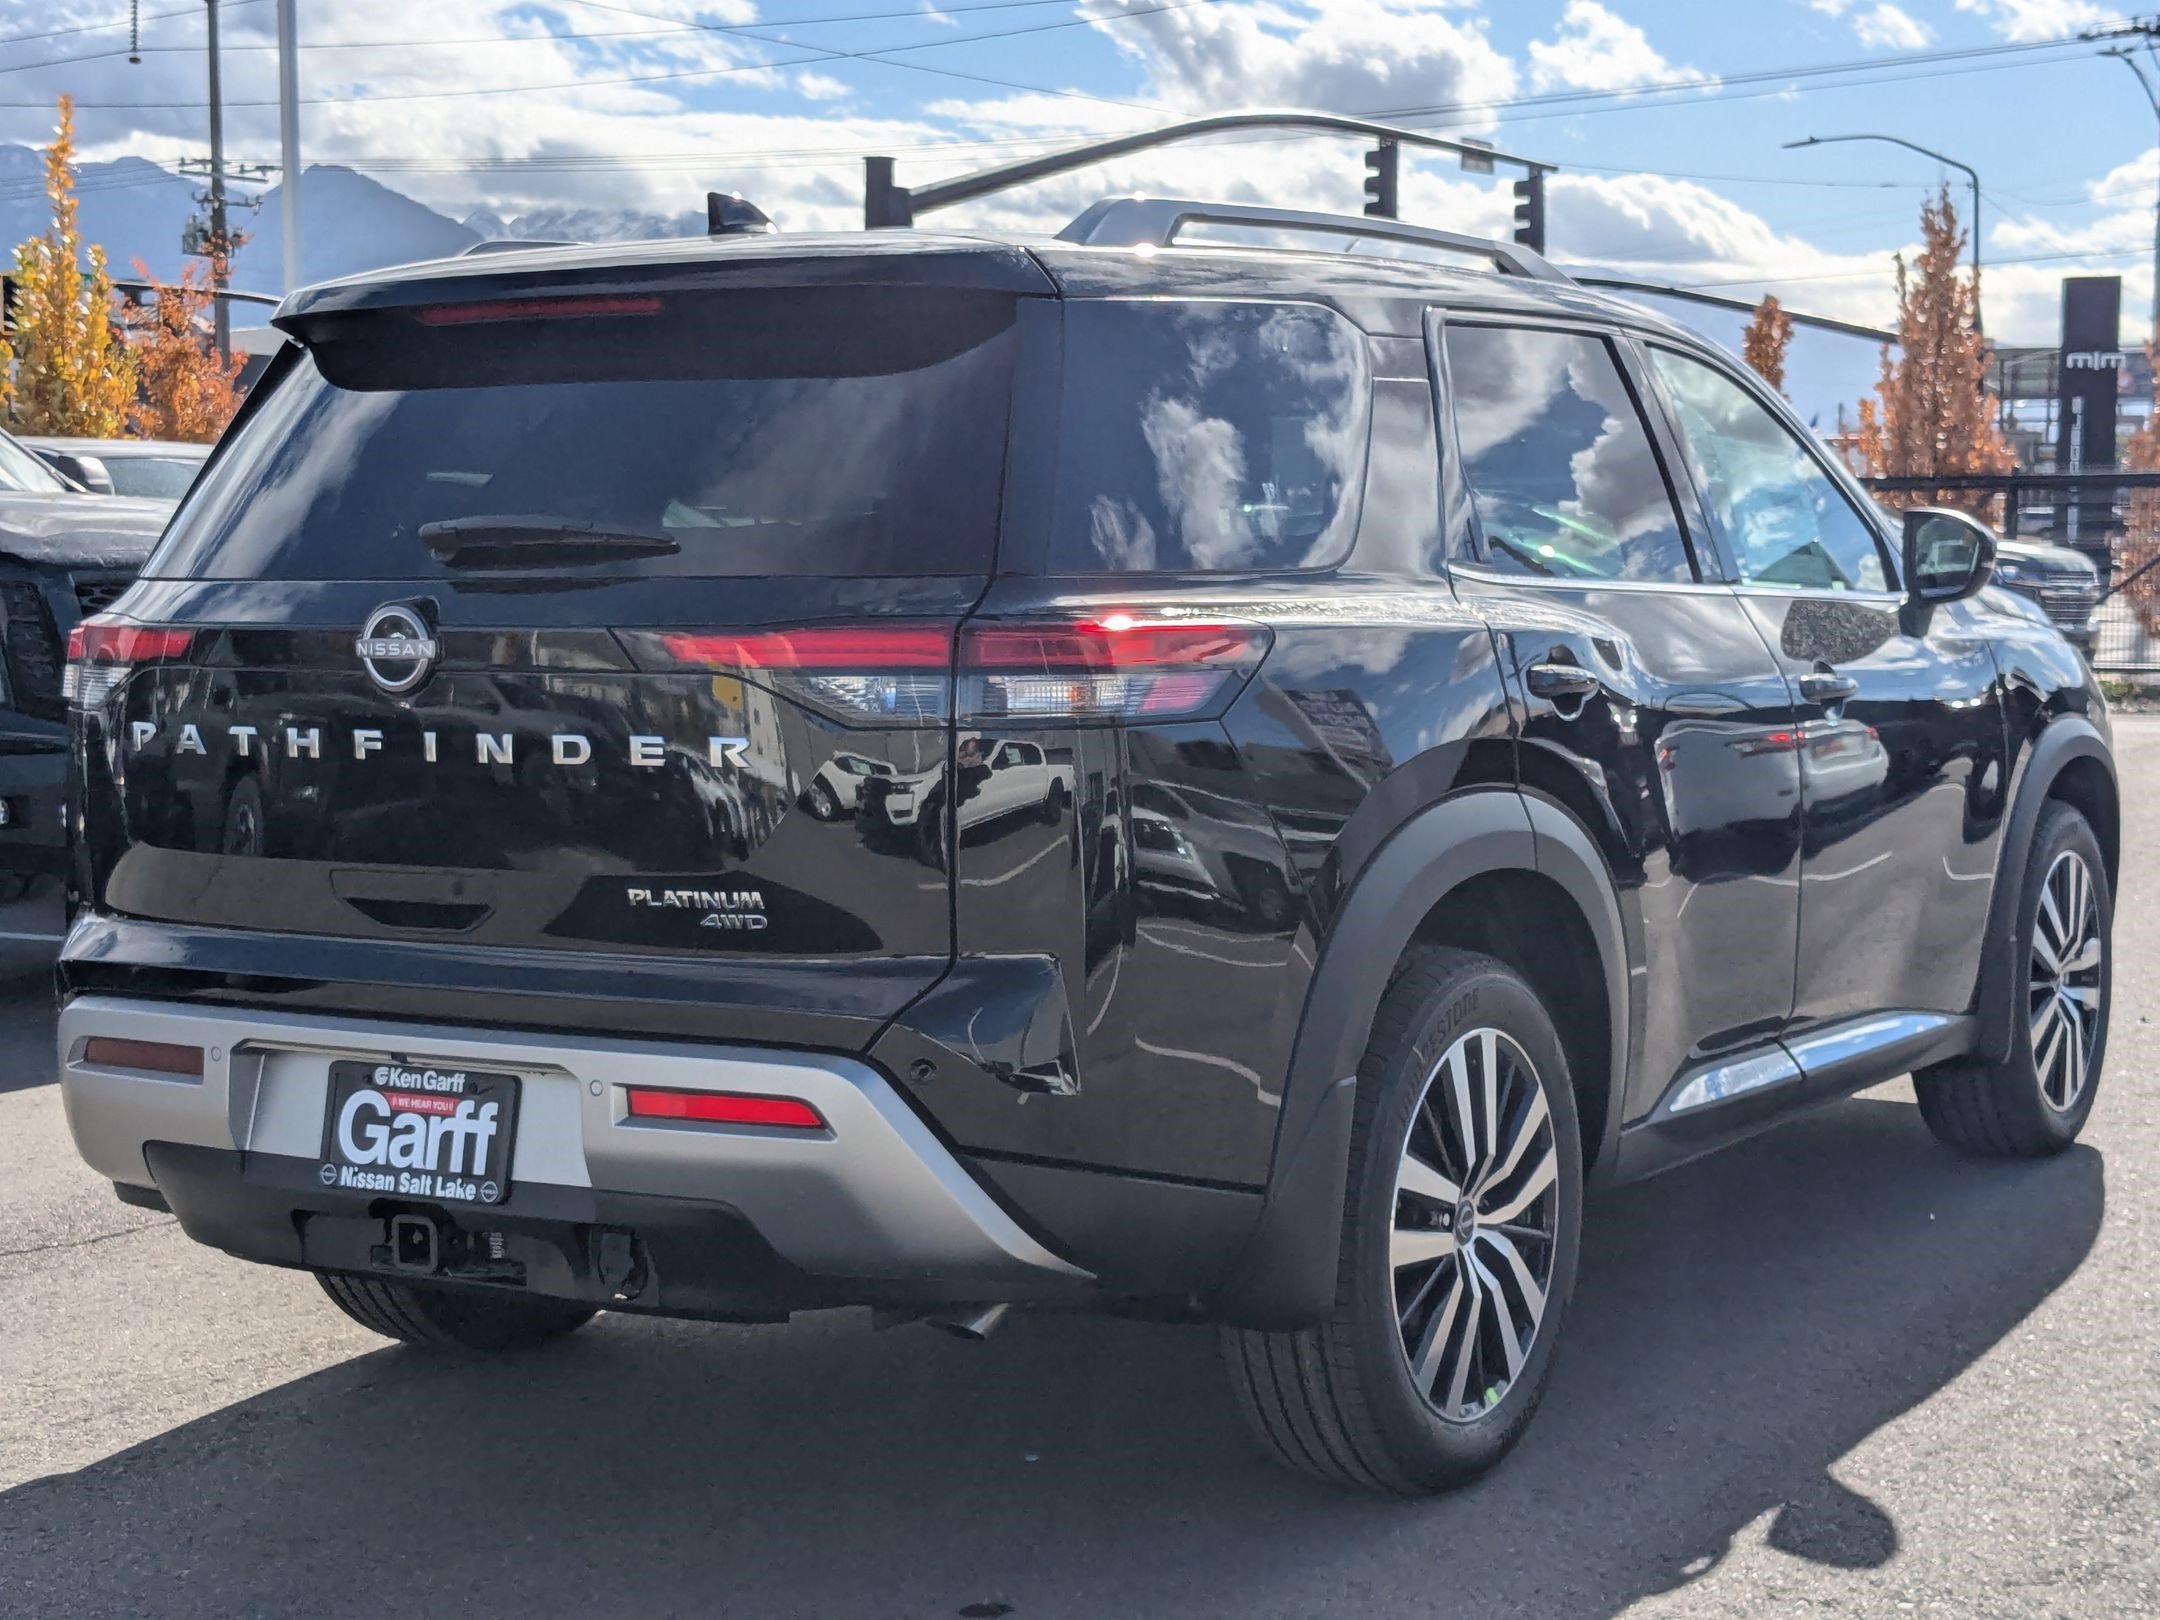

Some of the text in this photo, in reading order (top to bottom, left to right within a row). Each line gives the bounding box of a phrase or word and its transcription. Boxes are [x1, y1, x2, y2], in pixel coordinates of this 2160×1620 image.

[357, 642, 433, 656] NISSAN
[133, 722, 751, 768] PATHFINDER
[627, 888, 765, 910] PLATINUM
[700, 913, 768, 930] 4WD
[389, 1067, 466, 1093] Ken Garff
[399, 1097, 449, 1111] WE HEAR YOU
[339, 1090, 498, 1175] Garff
[340, 1166, 476, 1201] Nissan Salt Lake
